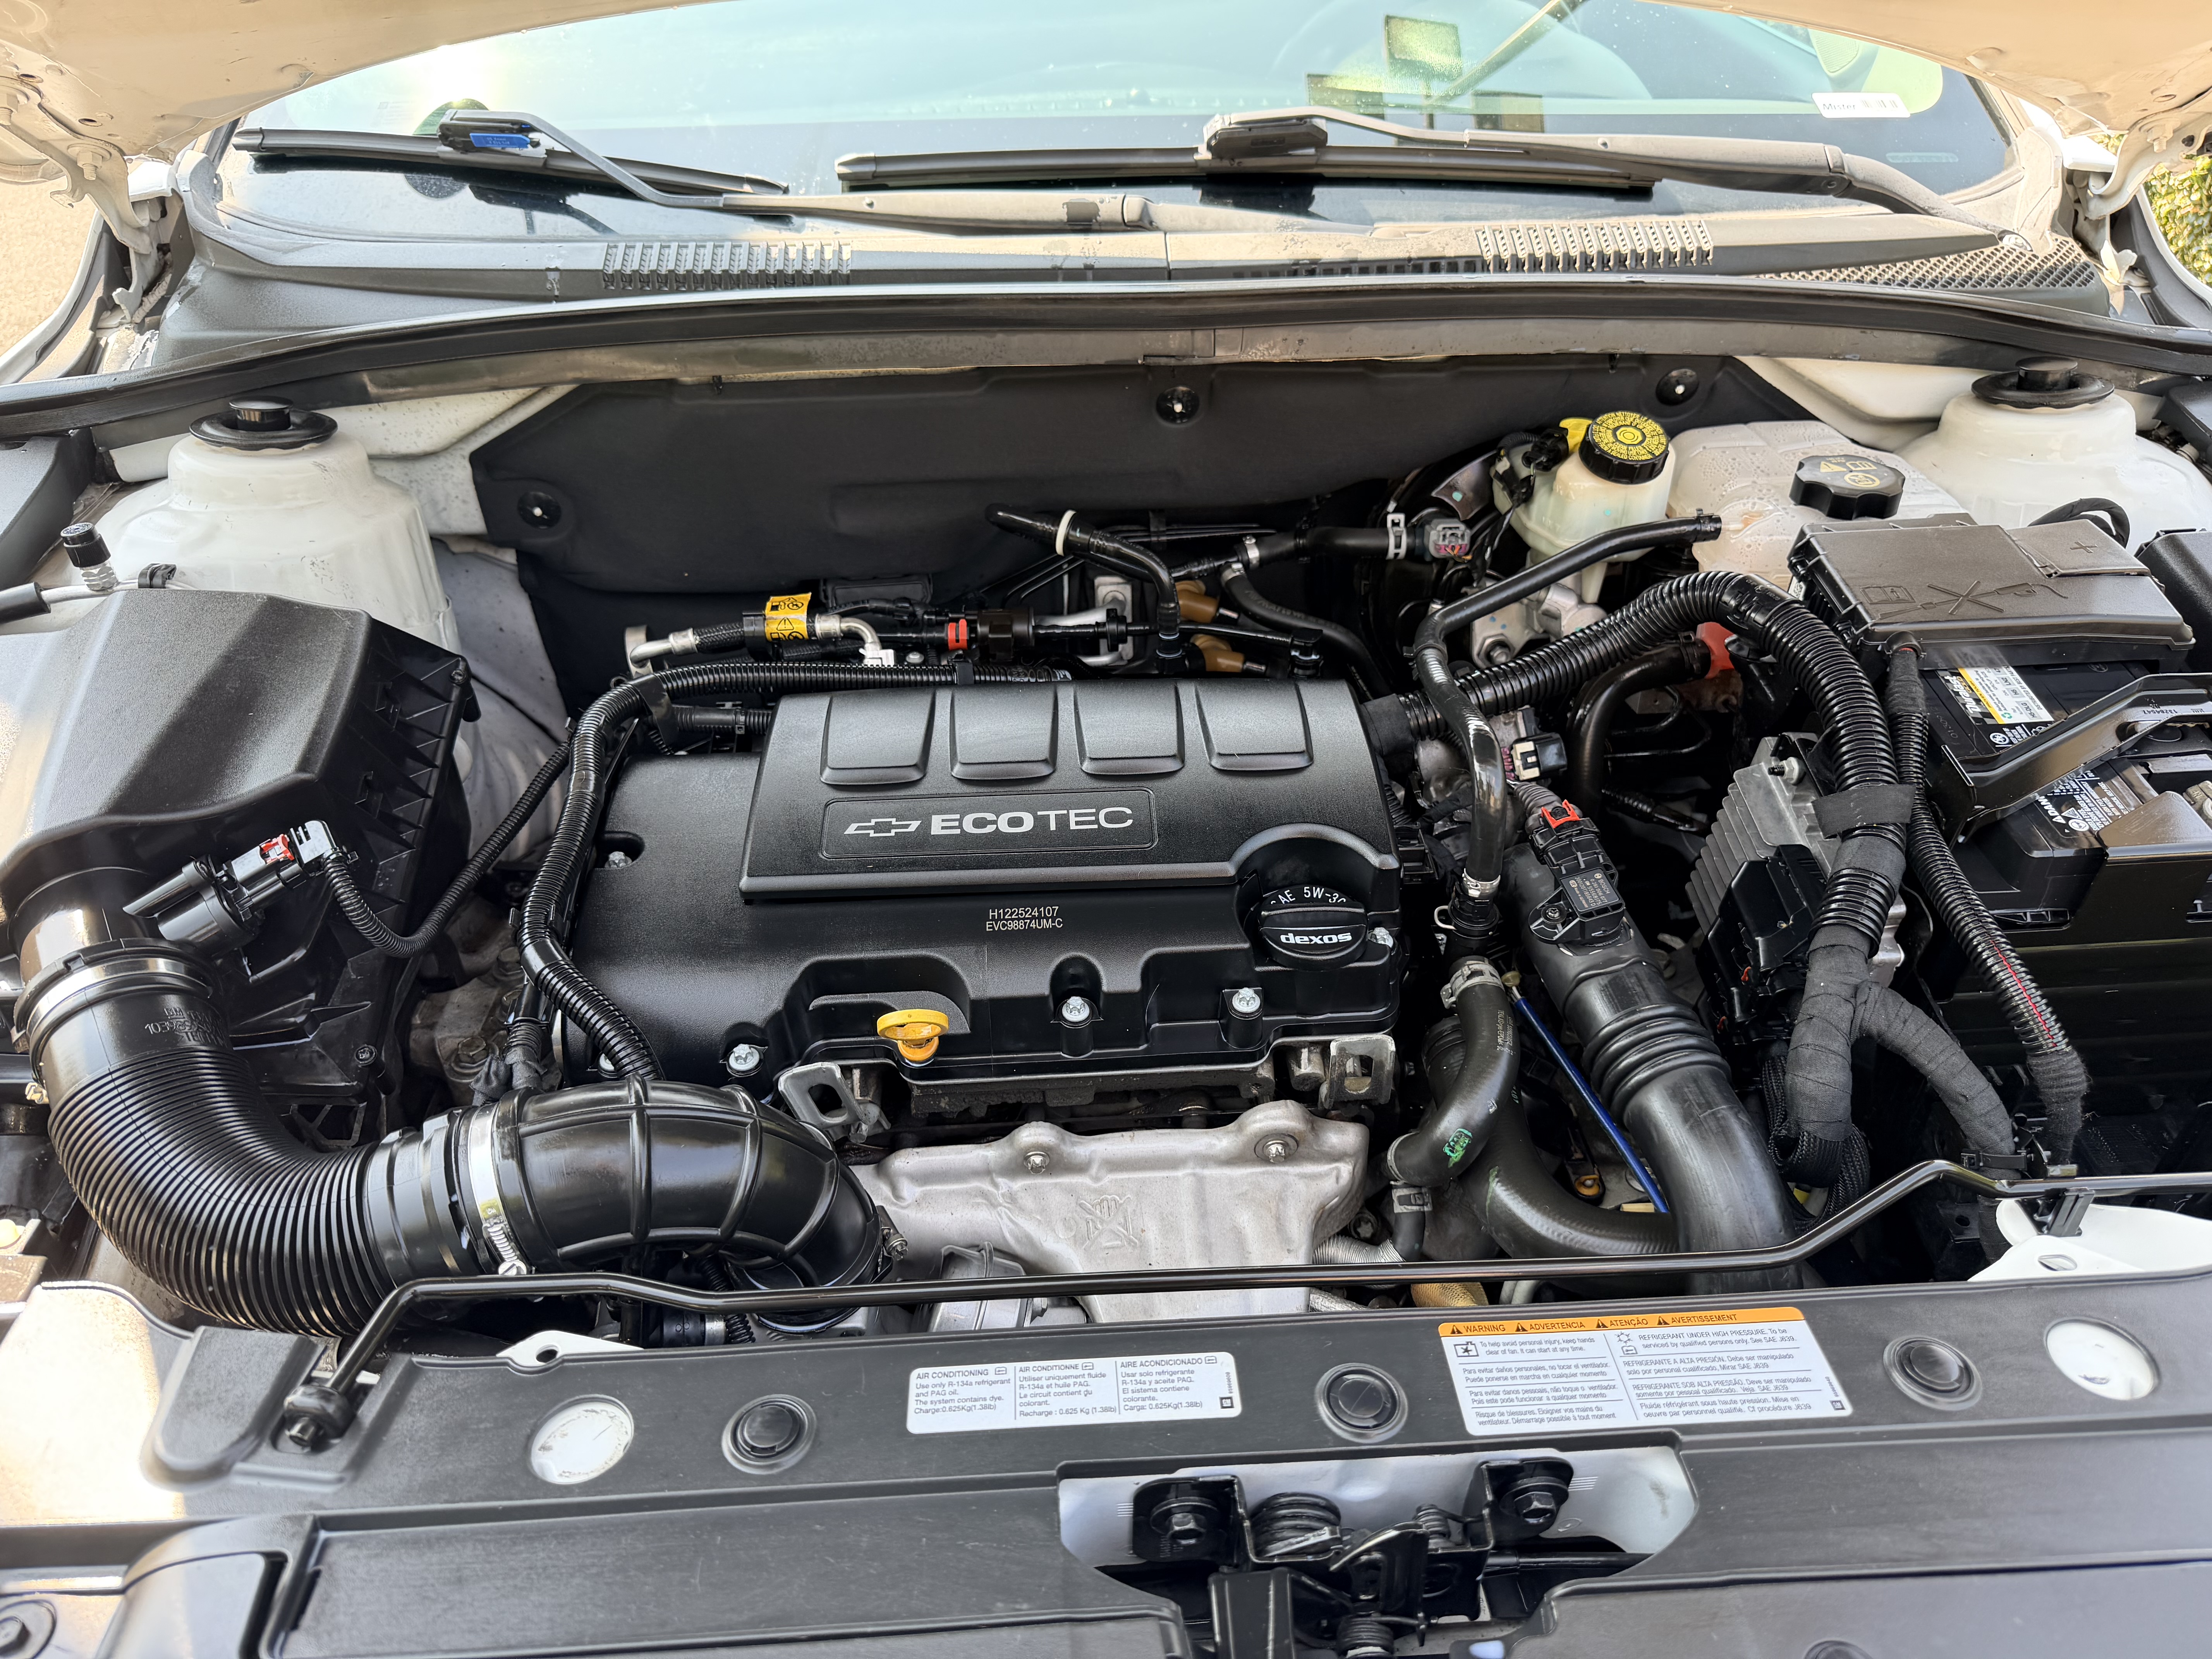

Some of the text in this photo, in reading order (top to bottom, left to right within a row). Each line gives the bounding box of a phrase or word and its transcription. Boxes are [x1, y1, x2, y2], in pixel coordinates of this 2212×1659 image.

[1956, 676, 1972, 693] GOLD
[1944, 675, 1981, 714] Duralast
[931, 807, 1133, 835] ECOTEC
[1597, 879, 1610, 894] BOSCH
[1587, 885, 1602, 905] 55568175
[989, 906, 1059, 920] H122524107
[986, 918, 1063, 931] EVC98874UM-C
[1280, 933, 1352, 944] dexos
[1463, 1314, 1736, 1333] WARNING ADVERTENCIA ATENÇÃO AVERTISSEMENT
[1139, 1357, 1202, 1367] ACONDICIONADO
[1623, 1358, 1672, 1367] REFRIGERANTE
[1032, 1364, 1079, 1372] CONDITIONNE
[1155, 1369, 1195, 1377] refrigerante
[1653, 1366, 1681, 1374] personal
[931, 1369, 988, 1379] CONDITIONING
[975, 1378, 1010, 1386] refrigerant
[1080, 1407, 1090, 1415] Kg
